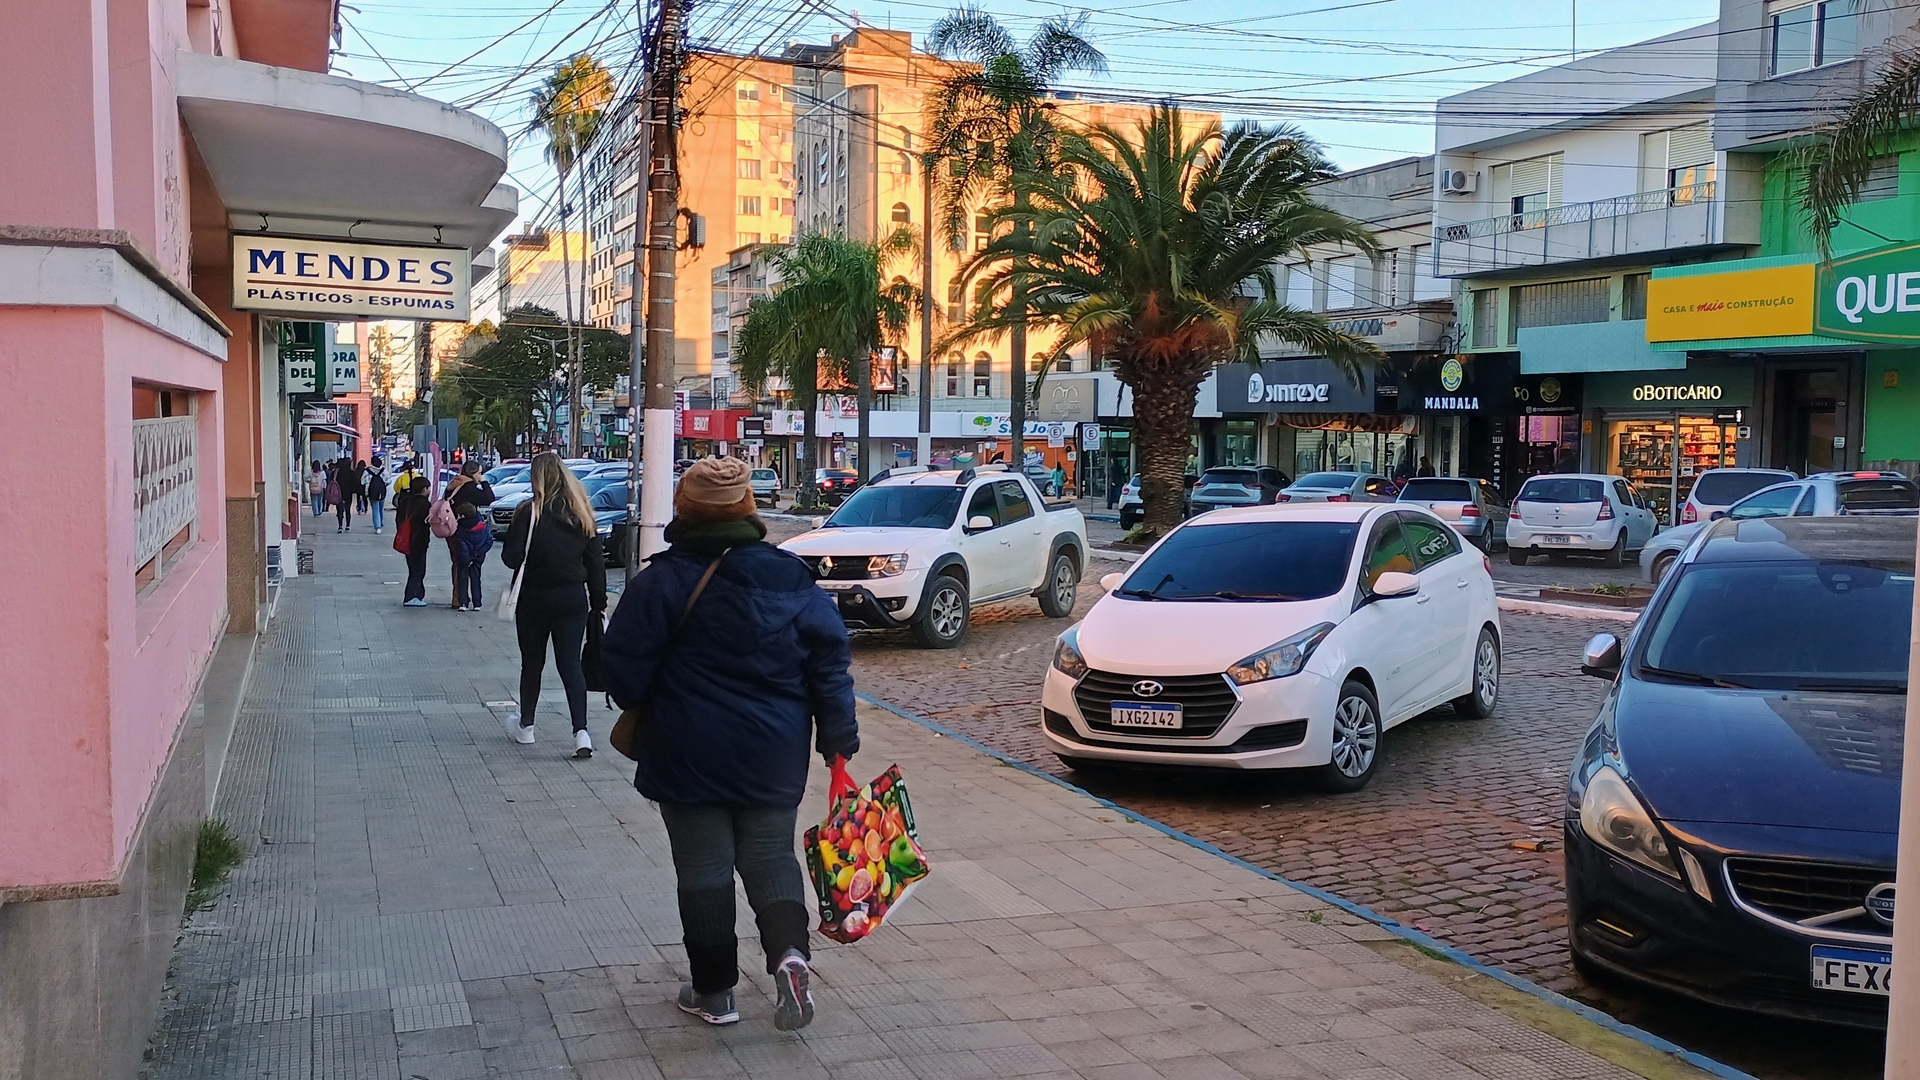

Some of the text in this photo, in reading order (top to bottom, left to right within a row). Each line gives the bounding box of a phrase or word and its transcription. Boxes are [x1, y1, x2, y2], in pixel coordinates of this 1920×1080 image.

[247, 248, 454, 285] MENDES
[247, 287, 353, 304] PLÁSTICOS
[368, 295, 455, 310] ESPUMAS
[1663, 295, 1795, 314] CASA E mais CONSTRUÇÃO
[1836, 271, 1920, 323] QUE
[1424, 397, 1479, 409] MANDALA
[1088, 429, 1094, 437] E
